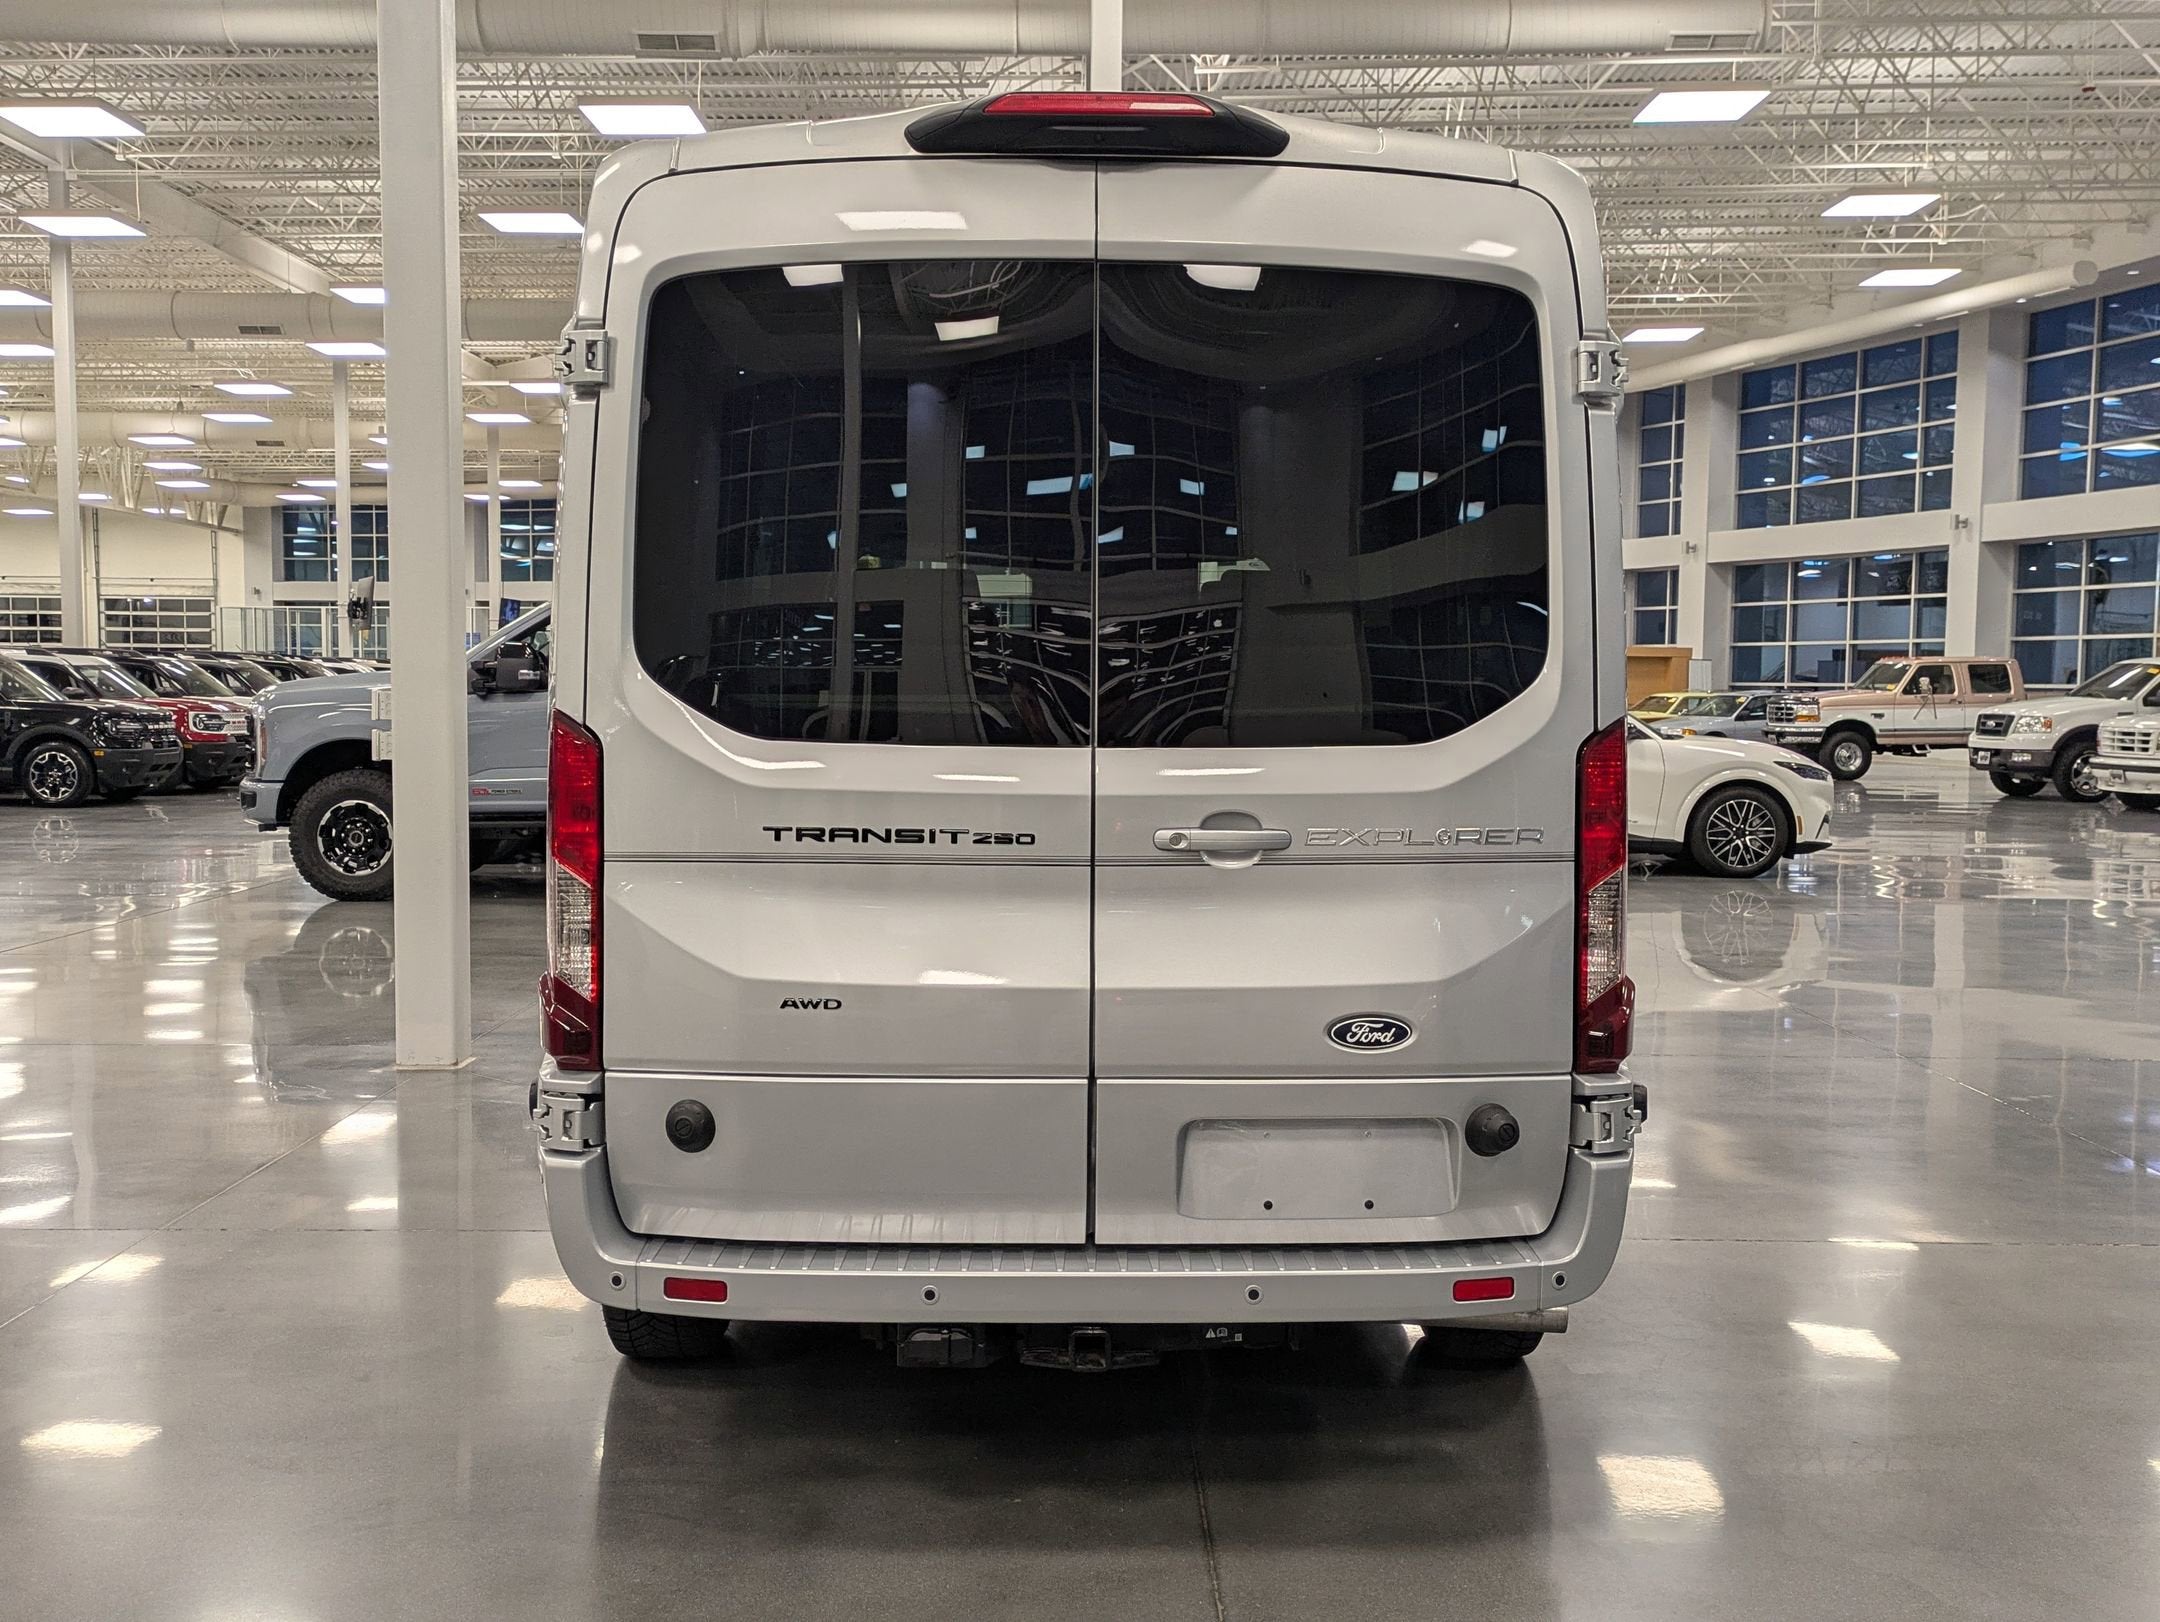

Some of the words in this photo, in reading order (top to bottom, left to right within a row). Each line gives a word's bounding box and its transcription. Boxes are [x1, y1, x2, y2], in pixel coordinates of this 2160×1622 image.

[1305, 827, 1544, 846] EXPLORER
[779, 997, 842, 1010] AWD
[1346, 1022, 1396, 1043] Ford
